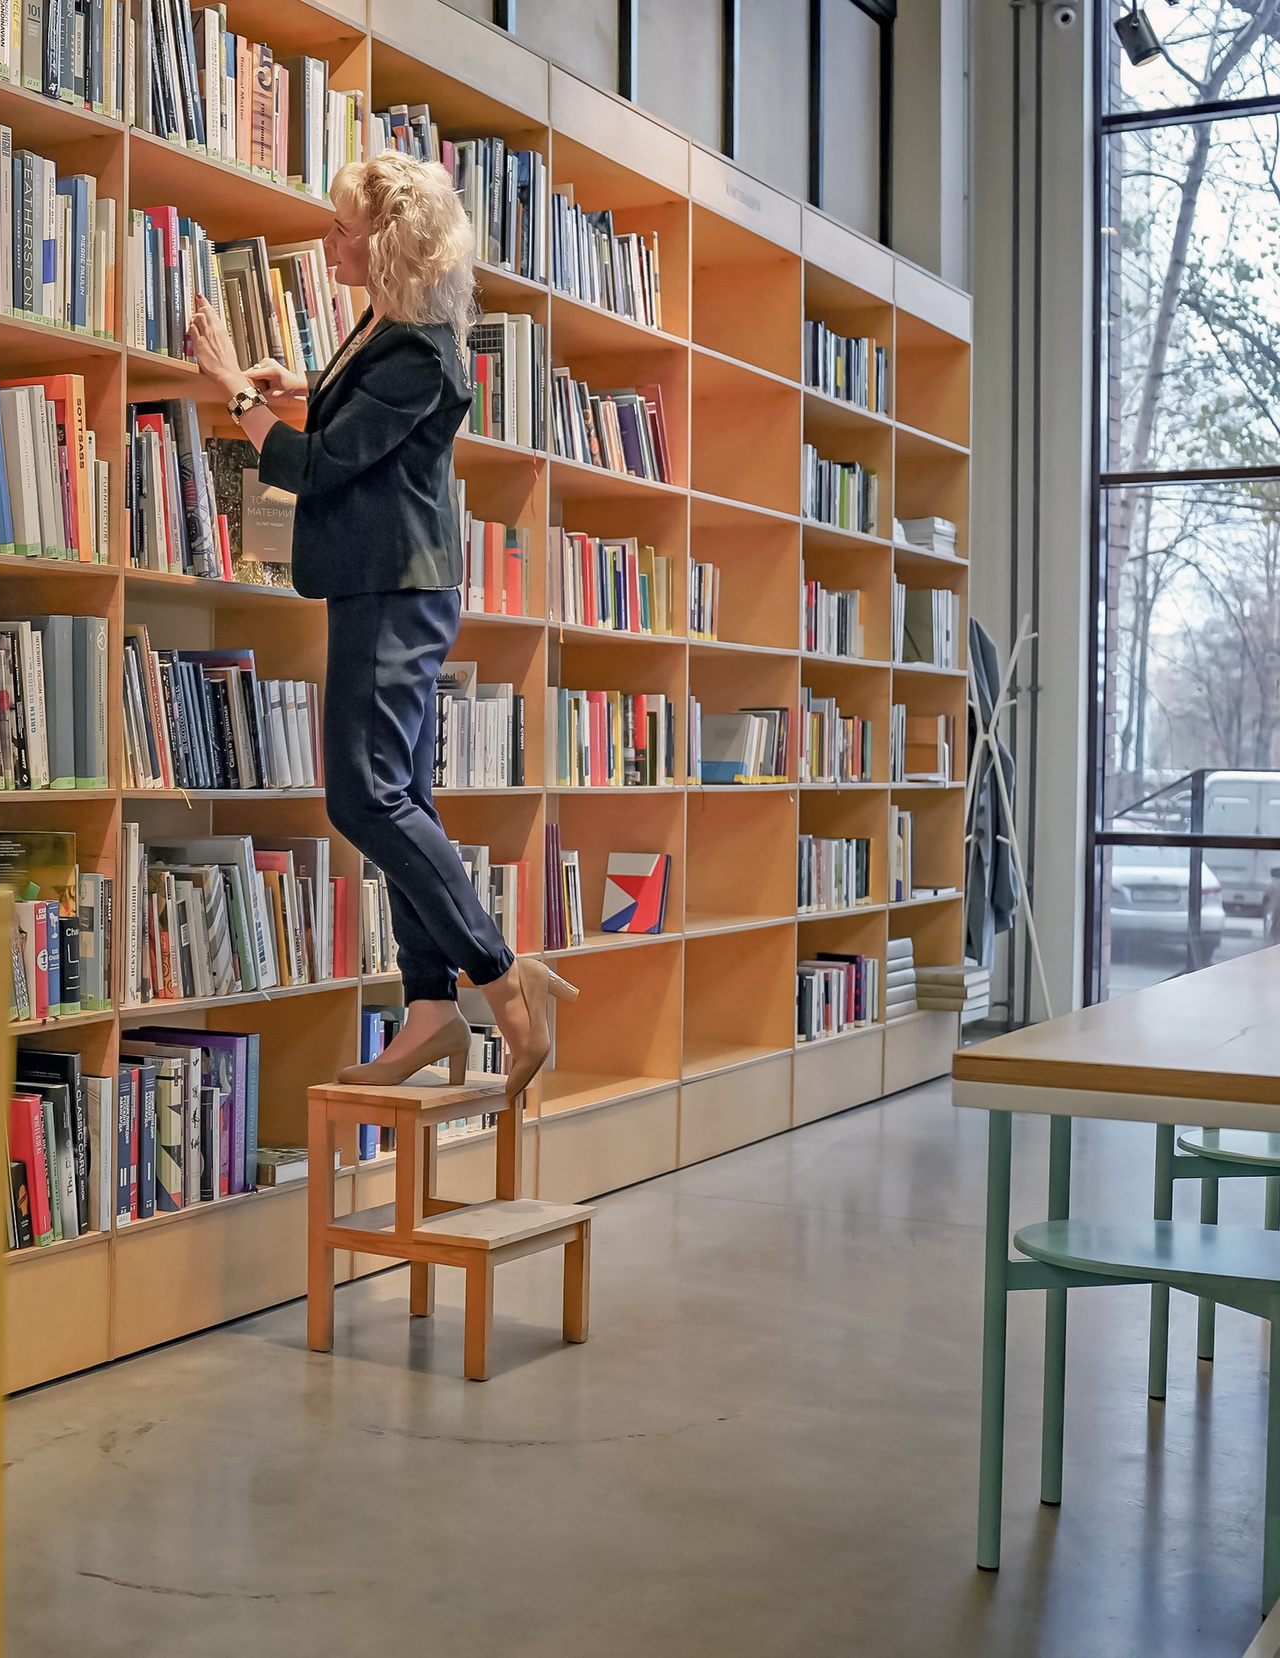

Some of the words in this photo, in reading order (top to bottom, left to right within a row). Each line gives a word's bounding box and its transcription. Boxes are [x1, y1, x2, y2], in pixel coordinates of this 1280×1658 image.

[27, 3, 40, 18] 101
[1, 131, 11, 158] WEGNER
[496, 142, 504, 177] Михаил
[76, 398, 85, 469] SOTTSASS
[247, 507, 293, 518] МАТЕРИИ
[75, 1089, 84, 1141] CLASSIC
[77, 1143, 86, 1177] CARS
